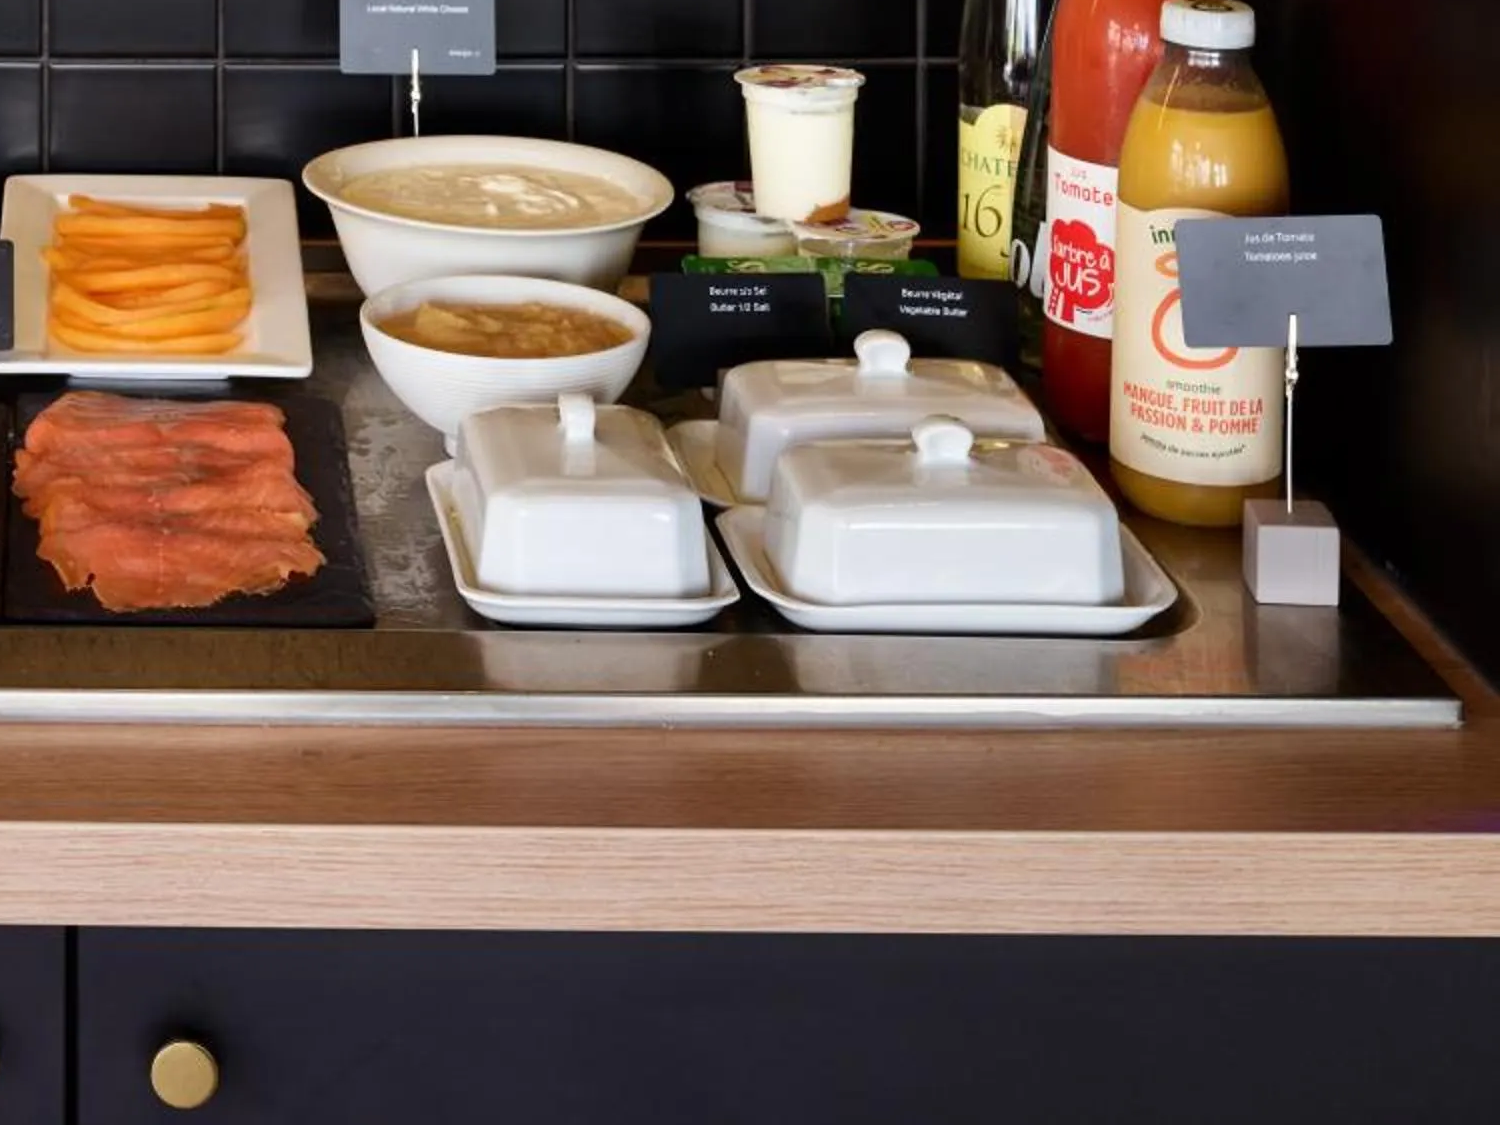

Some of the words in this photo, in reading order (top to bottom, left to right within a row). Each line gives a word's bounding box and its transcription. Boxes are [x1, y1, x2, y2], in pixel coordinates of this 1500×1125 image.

[1053, 172, 1114, 207] Tomate
[1130, 402, 1187, 432] PASSION
[1191, 418, 1204, 432] &
[1208, 417, 1259, 435] POMME
[1182, 396, 1227, 416] FRUIT
